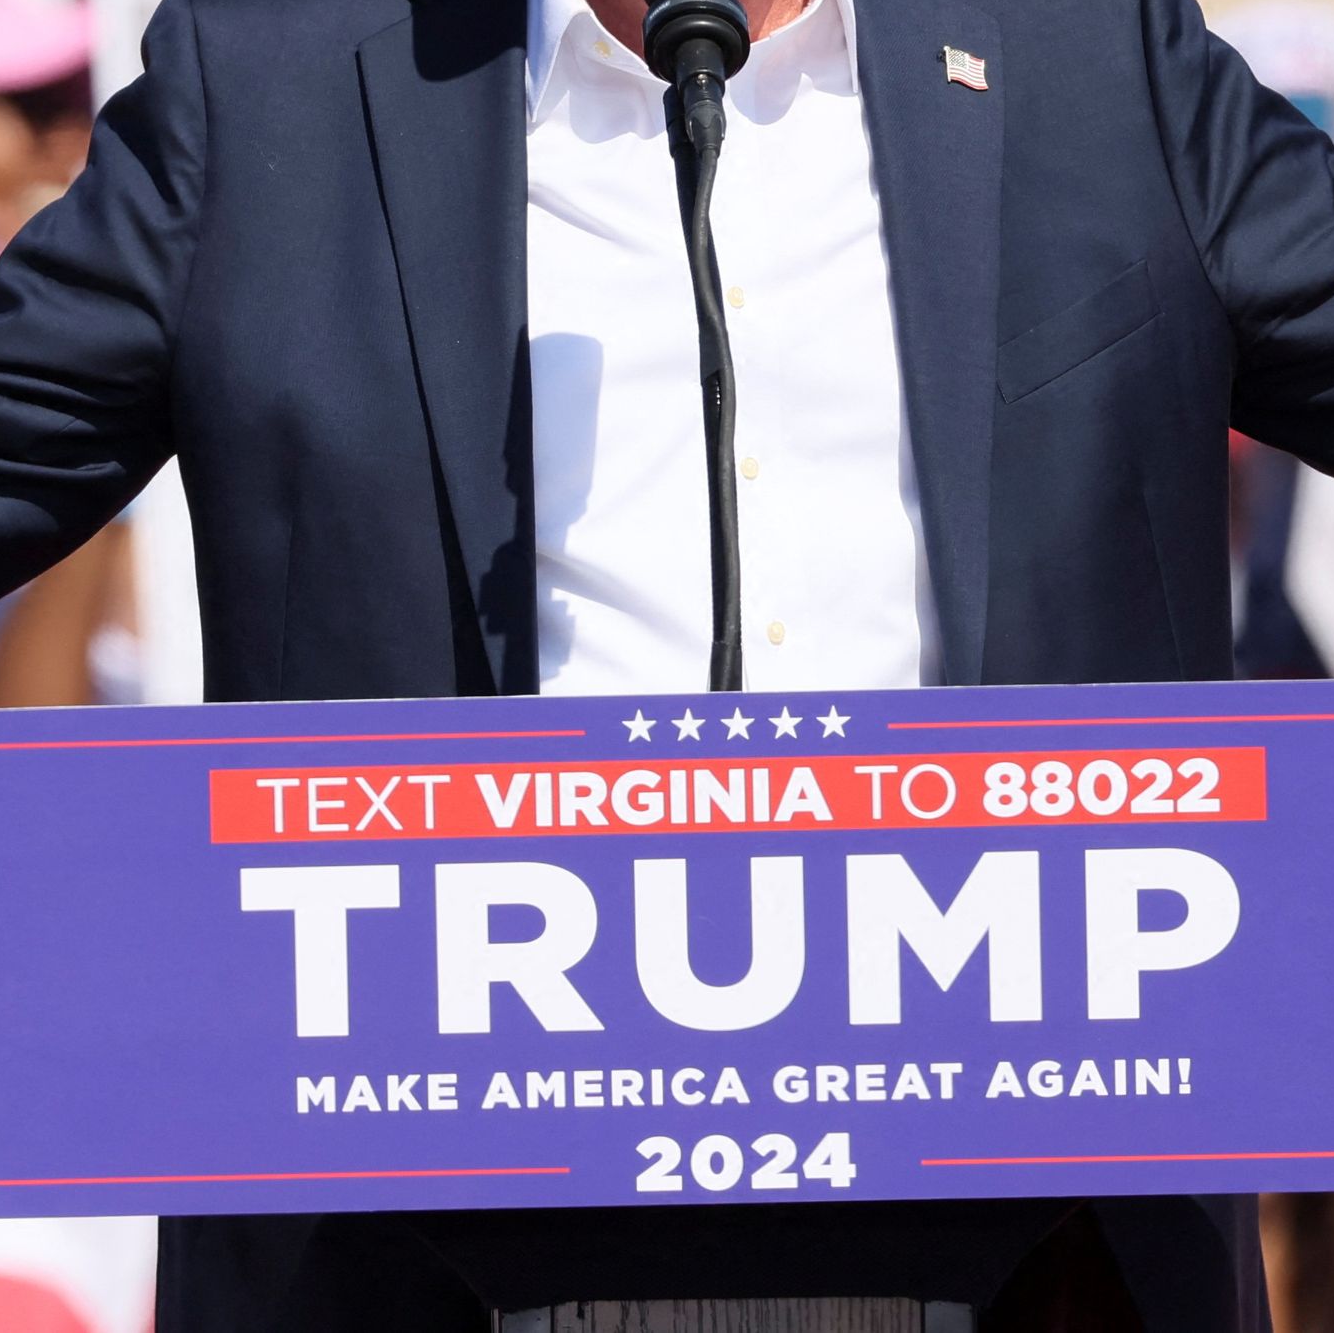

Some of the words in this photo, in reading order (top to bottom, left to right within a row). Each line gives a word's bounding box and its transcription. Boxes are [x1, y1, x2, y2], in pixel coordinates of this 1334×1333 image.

[256, 774, 451, 833] TEXT
[474, 767, 834, 829] VIRGINIA
[854, 763, 957, 820] TO
[982, 757, 1221, 818] 88022
[239, 847, 1241, 1039] TRUMP
[296, 1073, 459, 1114] MAKE
[481, 1066, 751, 1110] AMERICA
[772, 1062, 963, 1104] GREAT
[985, 1057, 1192, 1099] AGAIN!
[635, 1132, 857, 1192] 2024
